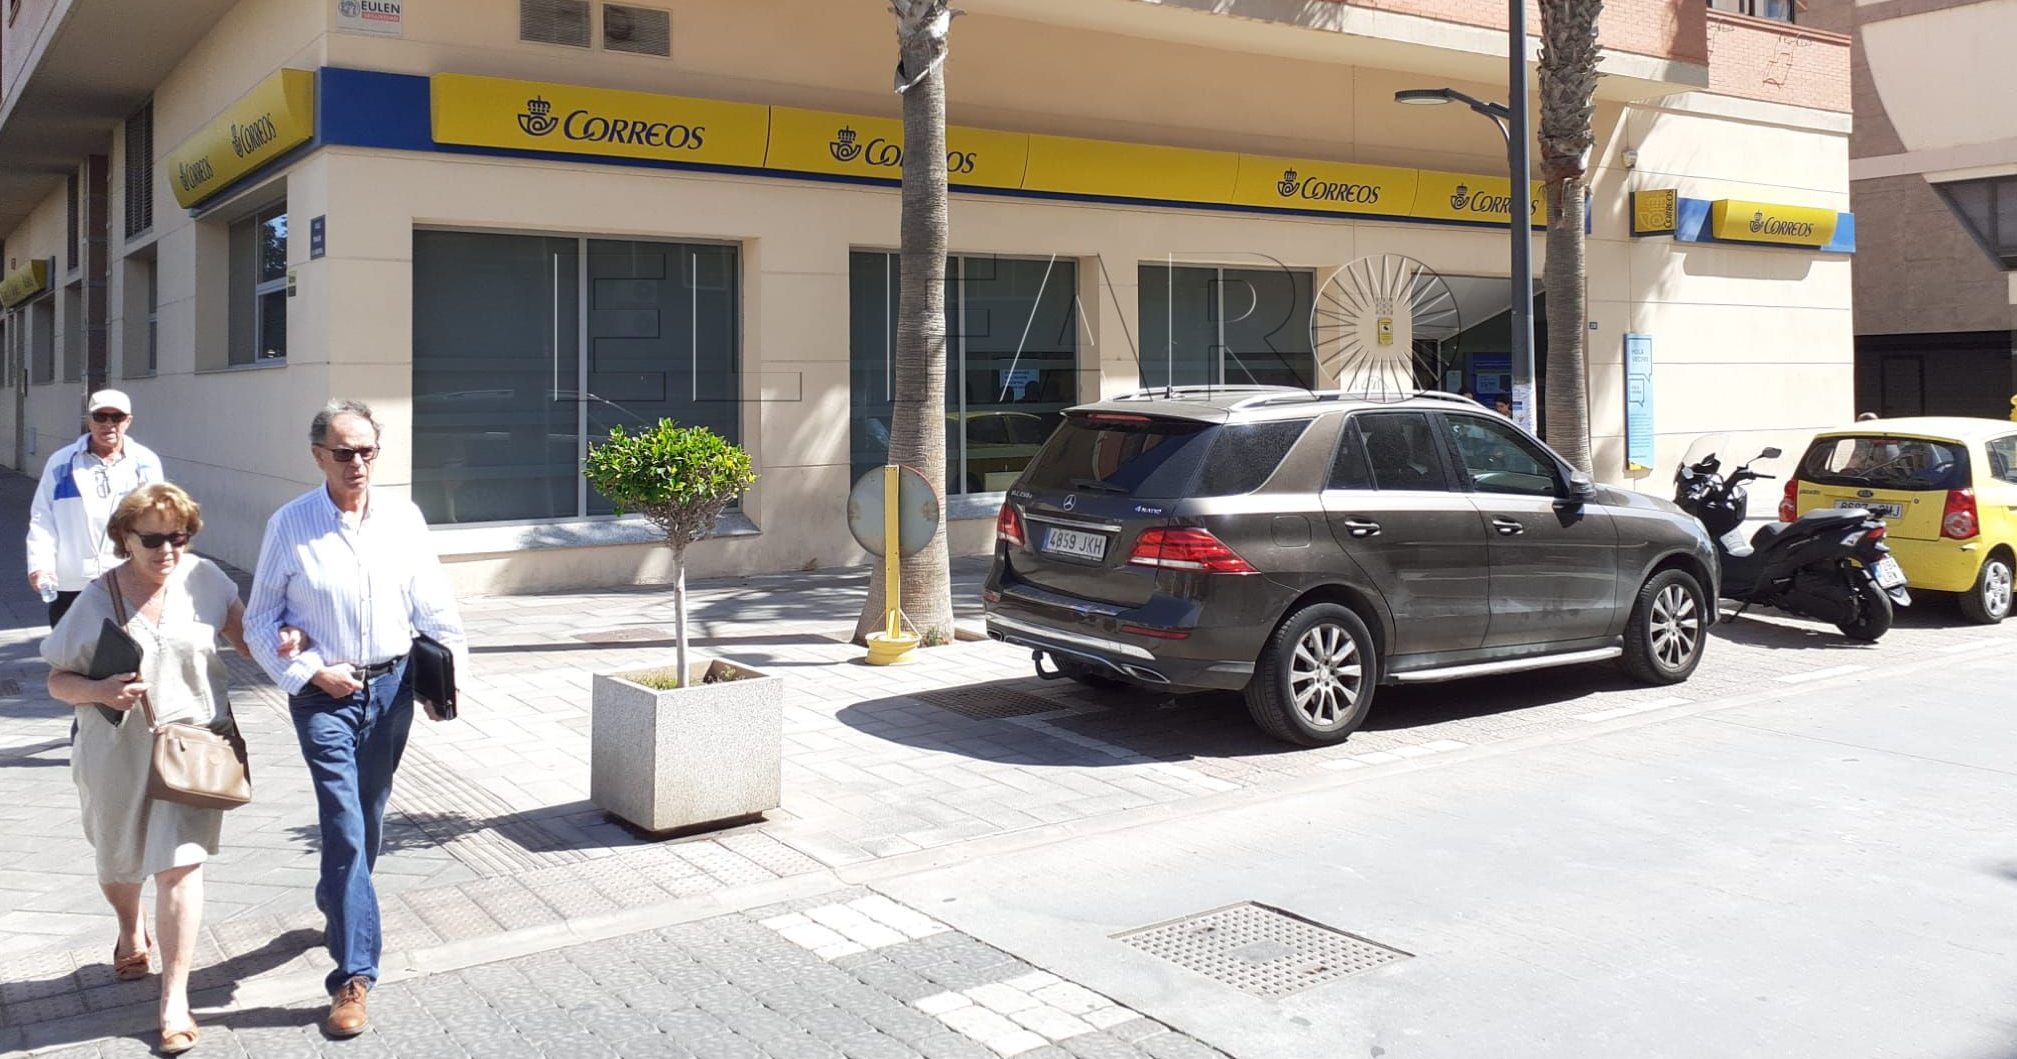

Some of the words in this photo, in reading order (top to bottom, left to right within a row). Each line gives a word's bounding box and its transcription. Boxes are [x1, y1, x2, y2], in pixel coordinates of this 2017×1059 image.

[361, 0, 400, 13] EULEN
[240, 112, 277, 154] CORREOS
[563, 110, 705, 150] CORREOS
[865, 138, 977, 174] COOS
[186, 155, 214, 189] CORREOS
[1301, 177, 1381, 204] CORREOS
[1471, 191, 1539, 216] CORRS
[1664, 190, 1673, 229] CORREOS
[1764, 216, 1814, 237] CORREOS
[1049, 529, 1077, 551] 4859
[1079, 537, 1103, 555] JKH
